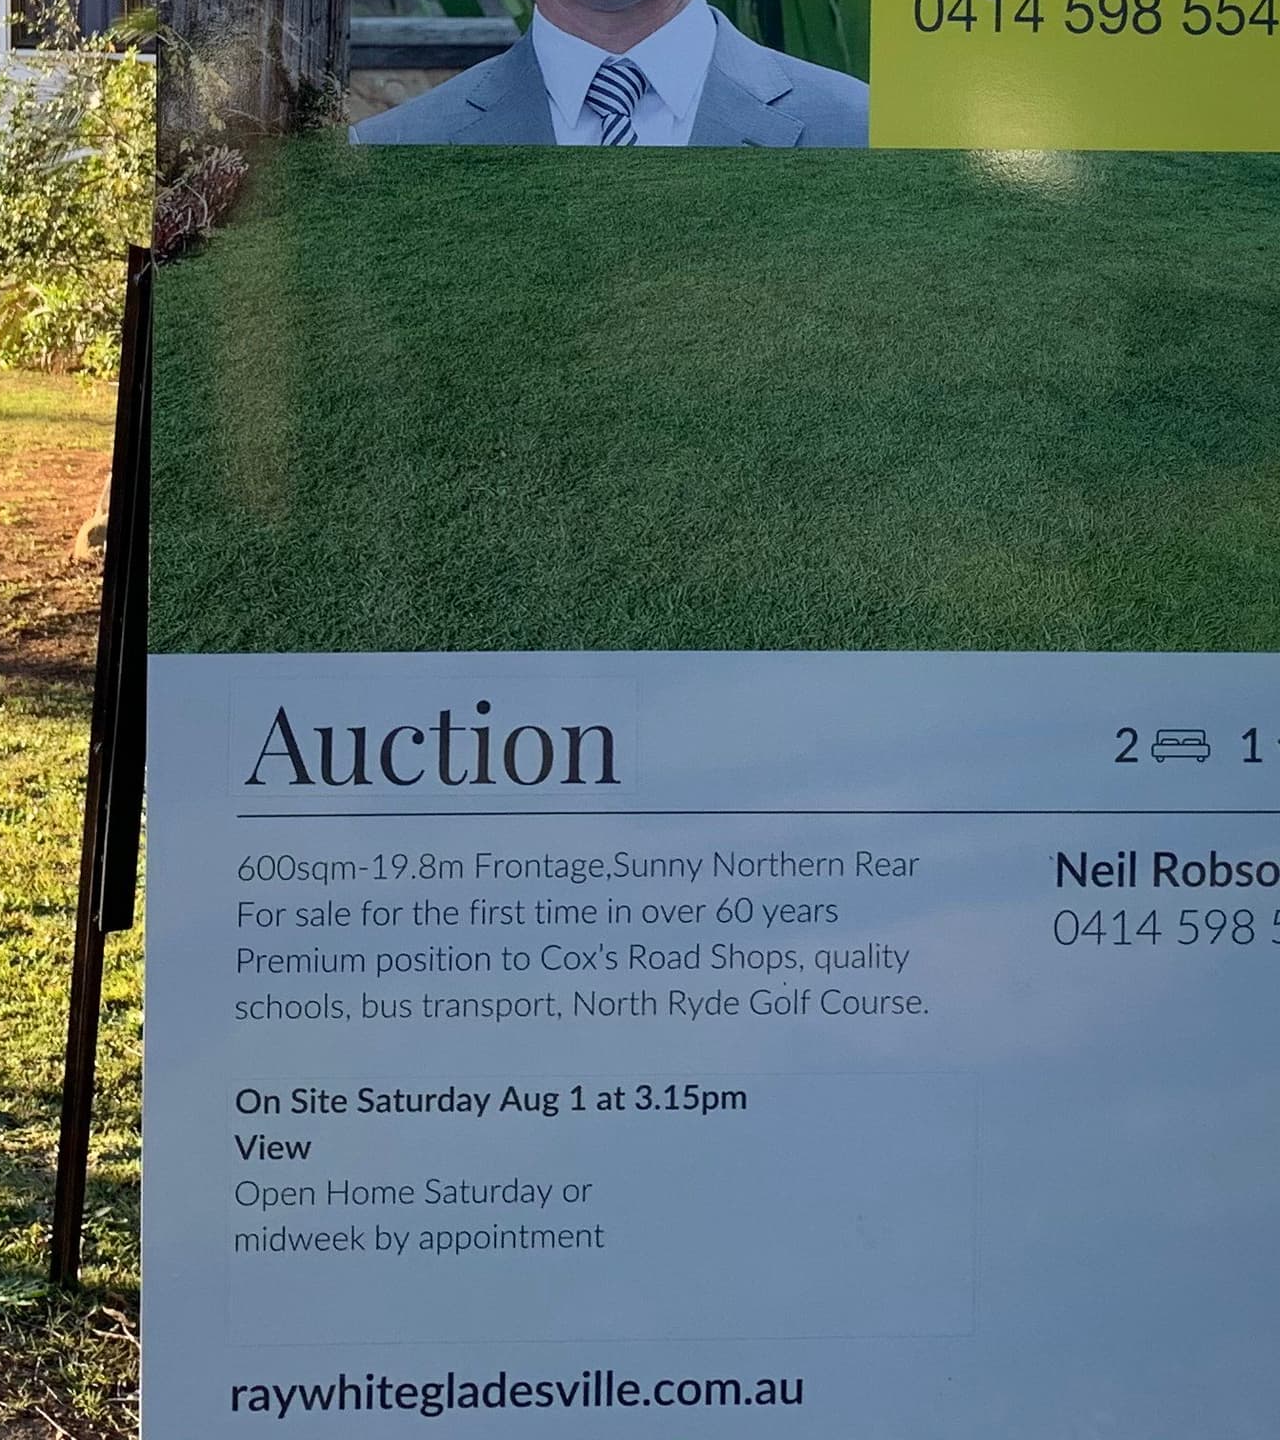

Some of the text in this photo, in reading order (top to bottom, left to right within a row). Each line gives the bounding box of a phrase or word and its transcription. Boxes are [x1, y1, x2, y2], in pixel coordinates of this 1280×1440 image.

[245, 700, 621, 786] Auction
[1115, 728, 1138, 762] 2
[1242, 728, 1262, 762] 1
[238, 854, 462, 885] 600sqm-19.8m
[714, 851, 843, 877] Northern
[857, 851, 919, 876] Rear
[1057, 851, 1136, 887] Neil
[239, 898, 838, 928] For sale for the first time in over 60 years
[1054, 910, 1162, 945] 0414
[1178, 909, 1254, 945] 598
[238, 943, 909, 978] Premium position to Cox's Road Shops, quality
[236, 989, 928, 1022] schools, bus transport, North Ryde Golf Course.
[236, 1085, 746, 1117] On Site Saturday Aug 1 at 3.15pm
[235, 1135, 311, 1160] View
[235, 1178, 592, 1211] Open Home Saturday or
[236, 1224, 604, 1255] midweek by appointment
[232, 1370, 802, 1419] raywhitegladesville.com.au
